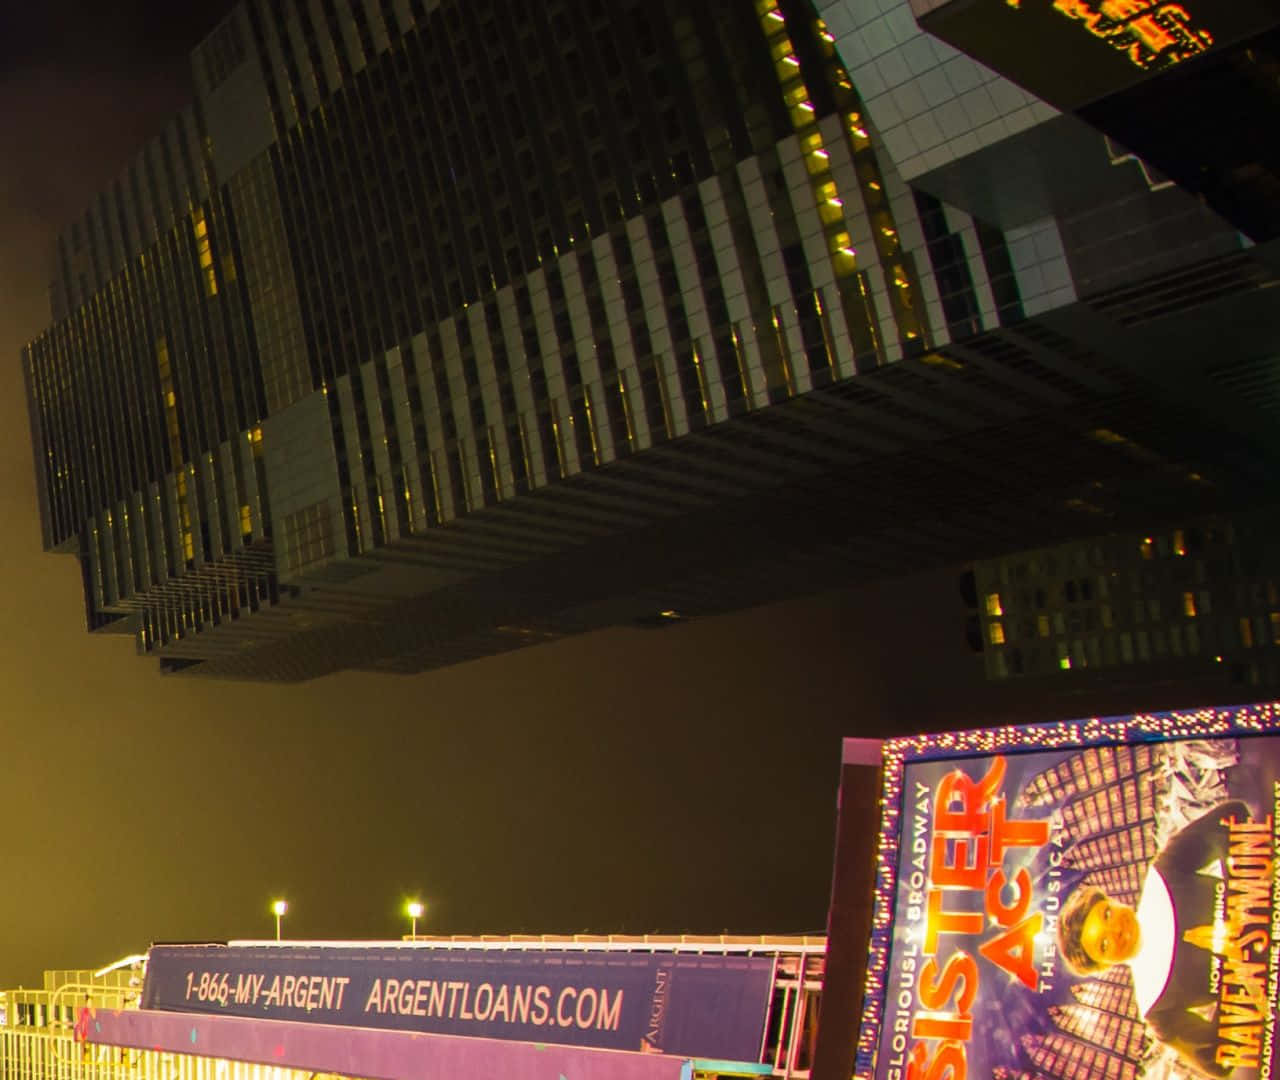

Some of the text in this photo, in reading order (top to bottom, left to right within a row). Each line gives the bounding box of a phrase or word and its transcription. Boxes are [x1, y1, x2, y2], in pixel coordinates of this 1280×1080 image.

[906, 781, 931, 923] BROADWAY
[979, 793, 1050, 992] ACT
[1040, 819, 1065, 993] THE MUSICAL
[185, 971, 624, 1031] 1-866-MY-ARGENT ARGENTLOANS.COM
[645, 969, 669, 1044] ARGENT
[1210, 954, 1224, 994] NOW
